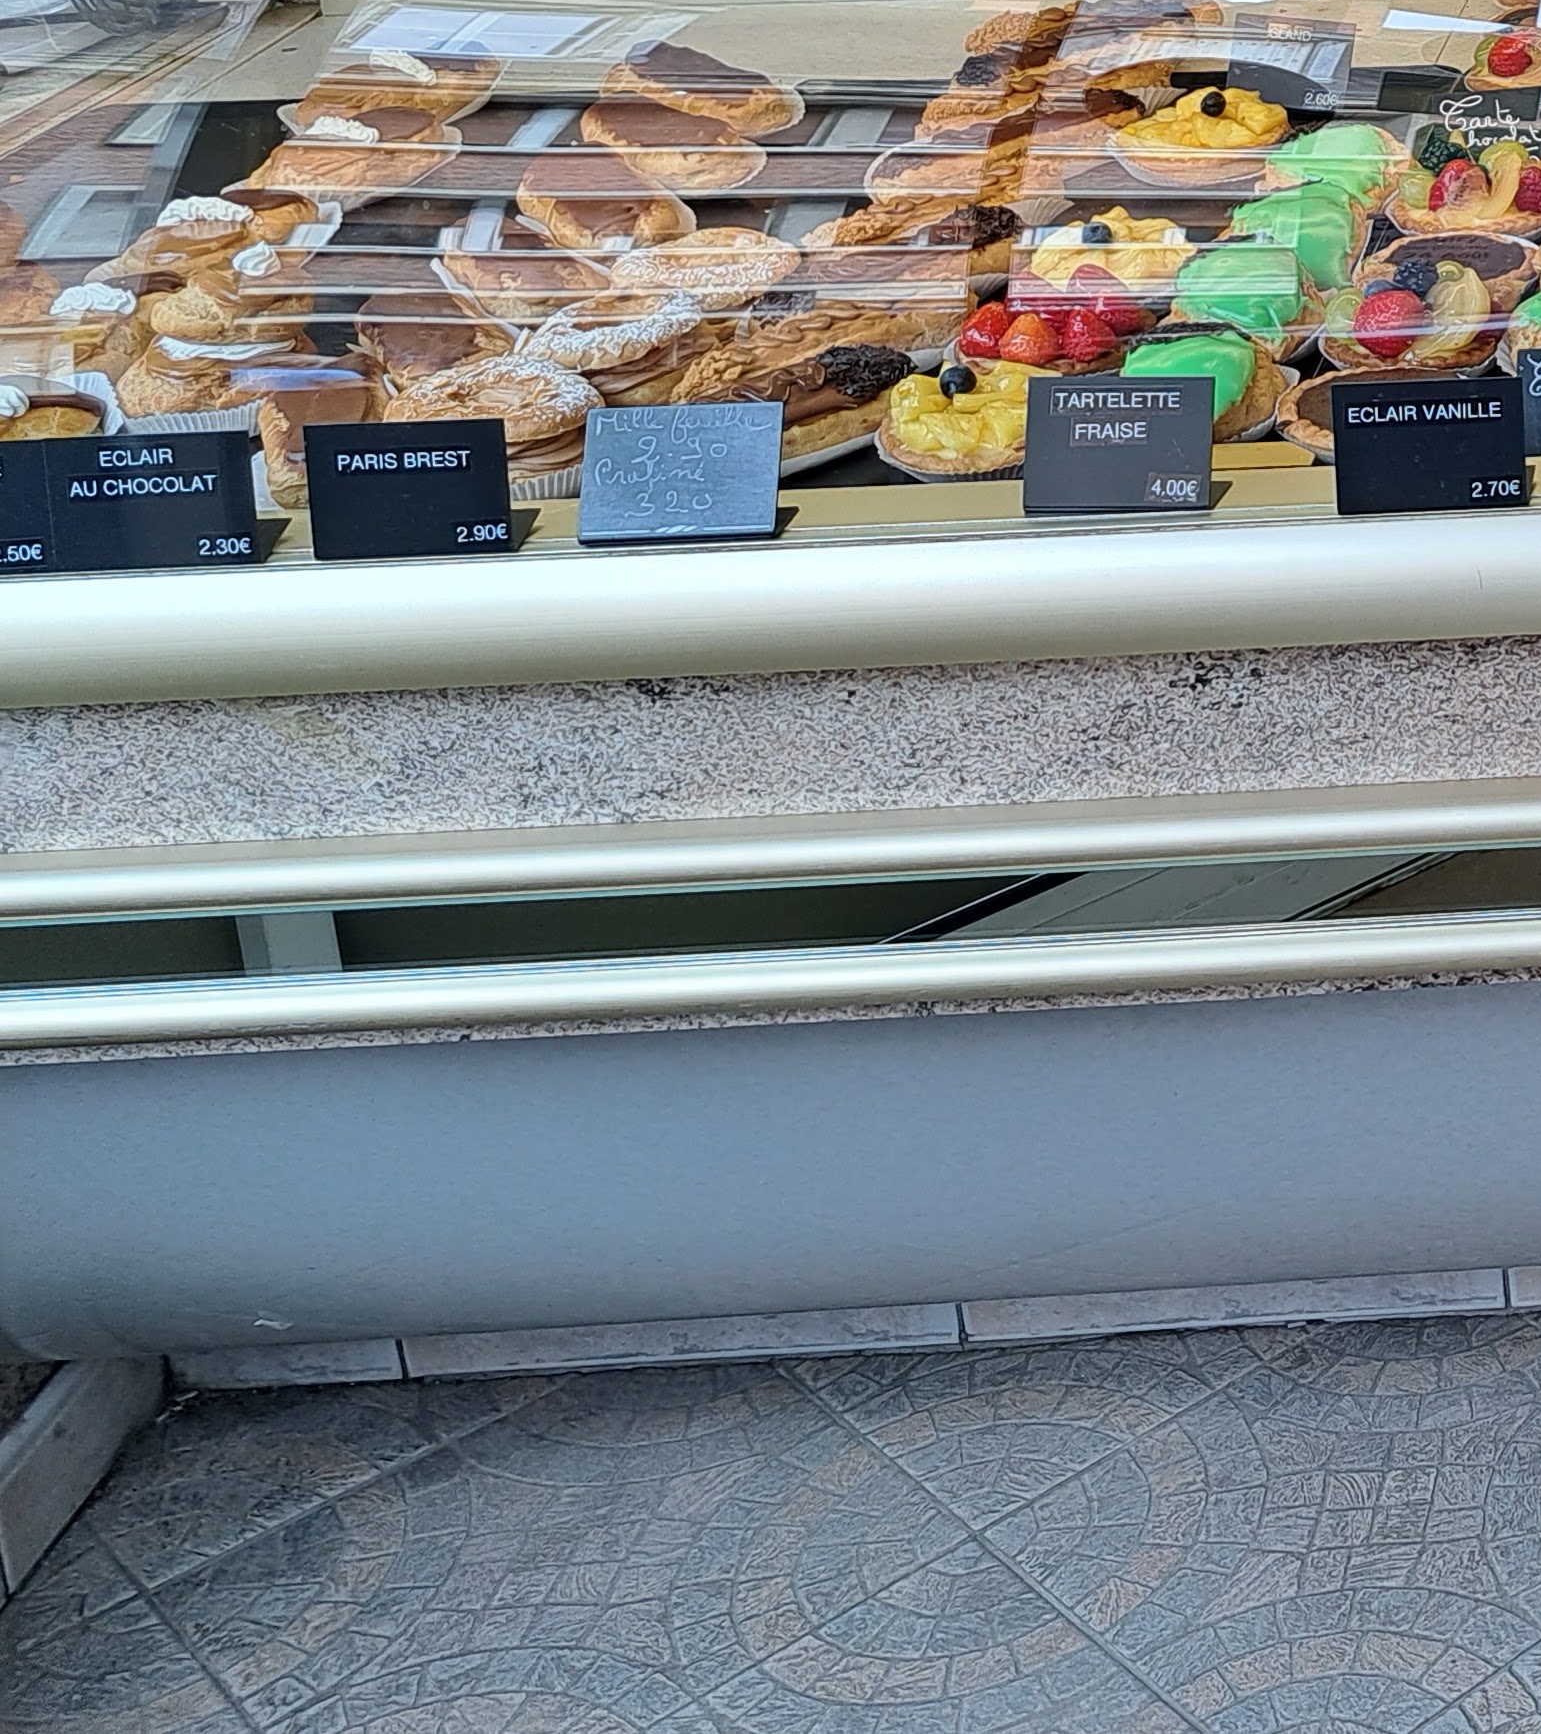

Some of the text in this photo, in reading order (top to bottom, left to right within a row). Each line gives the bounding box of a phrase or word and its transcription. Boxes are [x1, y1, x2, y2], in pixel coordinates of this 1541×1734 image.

[1439, 94, 1521, 132] Tarte
[1054, 390, 1182, 411] TARTELETTE
[1347, 400, 1502, 425] ECLAIR VANILLE
[1073, 421, 1147, 441] FRAISE
[99, 447, 174, 468] ECLAIR
[337, 448, 471, 473] PARIS BREST
[69, 473, 218, 499] AU CHOCOLAT
[1471, 479, 1521, 499] 2.70€
[456, 522, 509, 544] 2.90€
[198, 536, 253, 557] 2.30€
